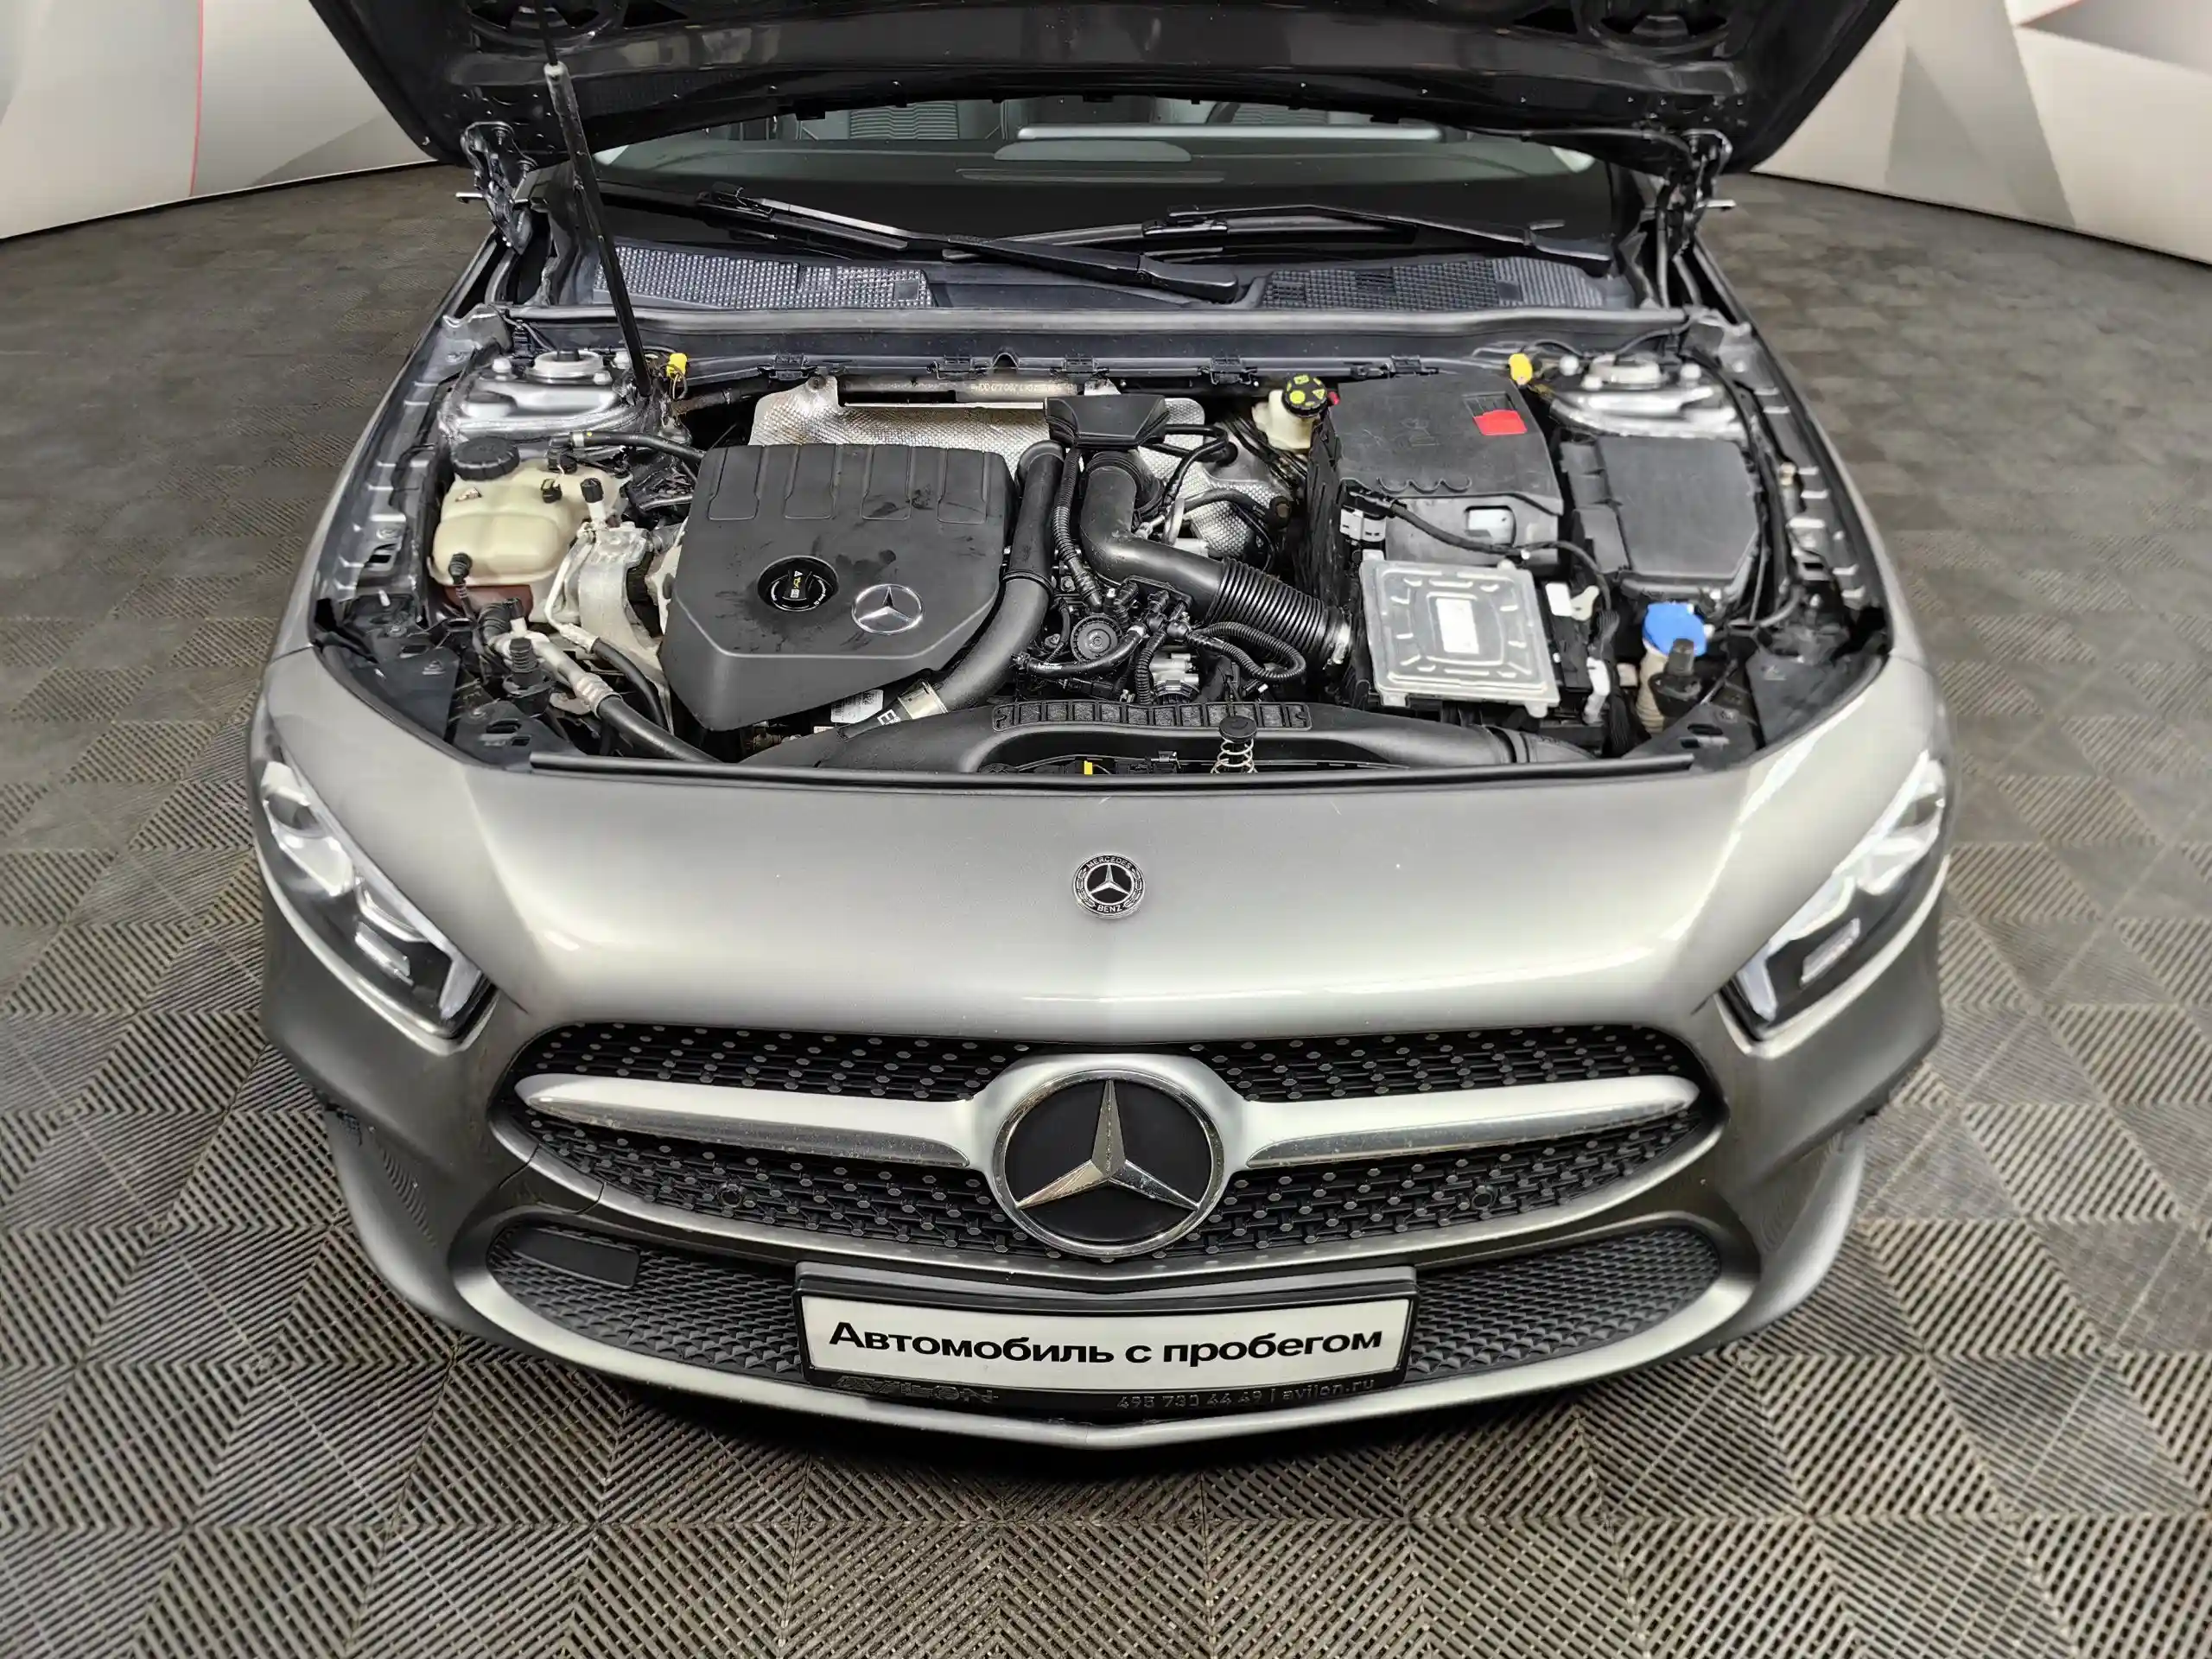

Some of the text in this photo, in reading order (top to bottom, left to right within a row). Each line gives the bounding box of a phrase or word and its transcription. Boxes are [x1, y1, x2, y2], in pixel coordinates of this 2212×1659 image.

[1086, 856, 1132, 868] MERCEDES
[829, 1321, 1382, 1367] Автомобиль с пробегом
